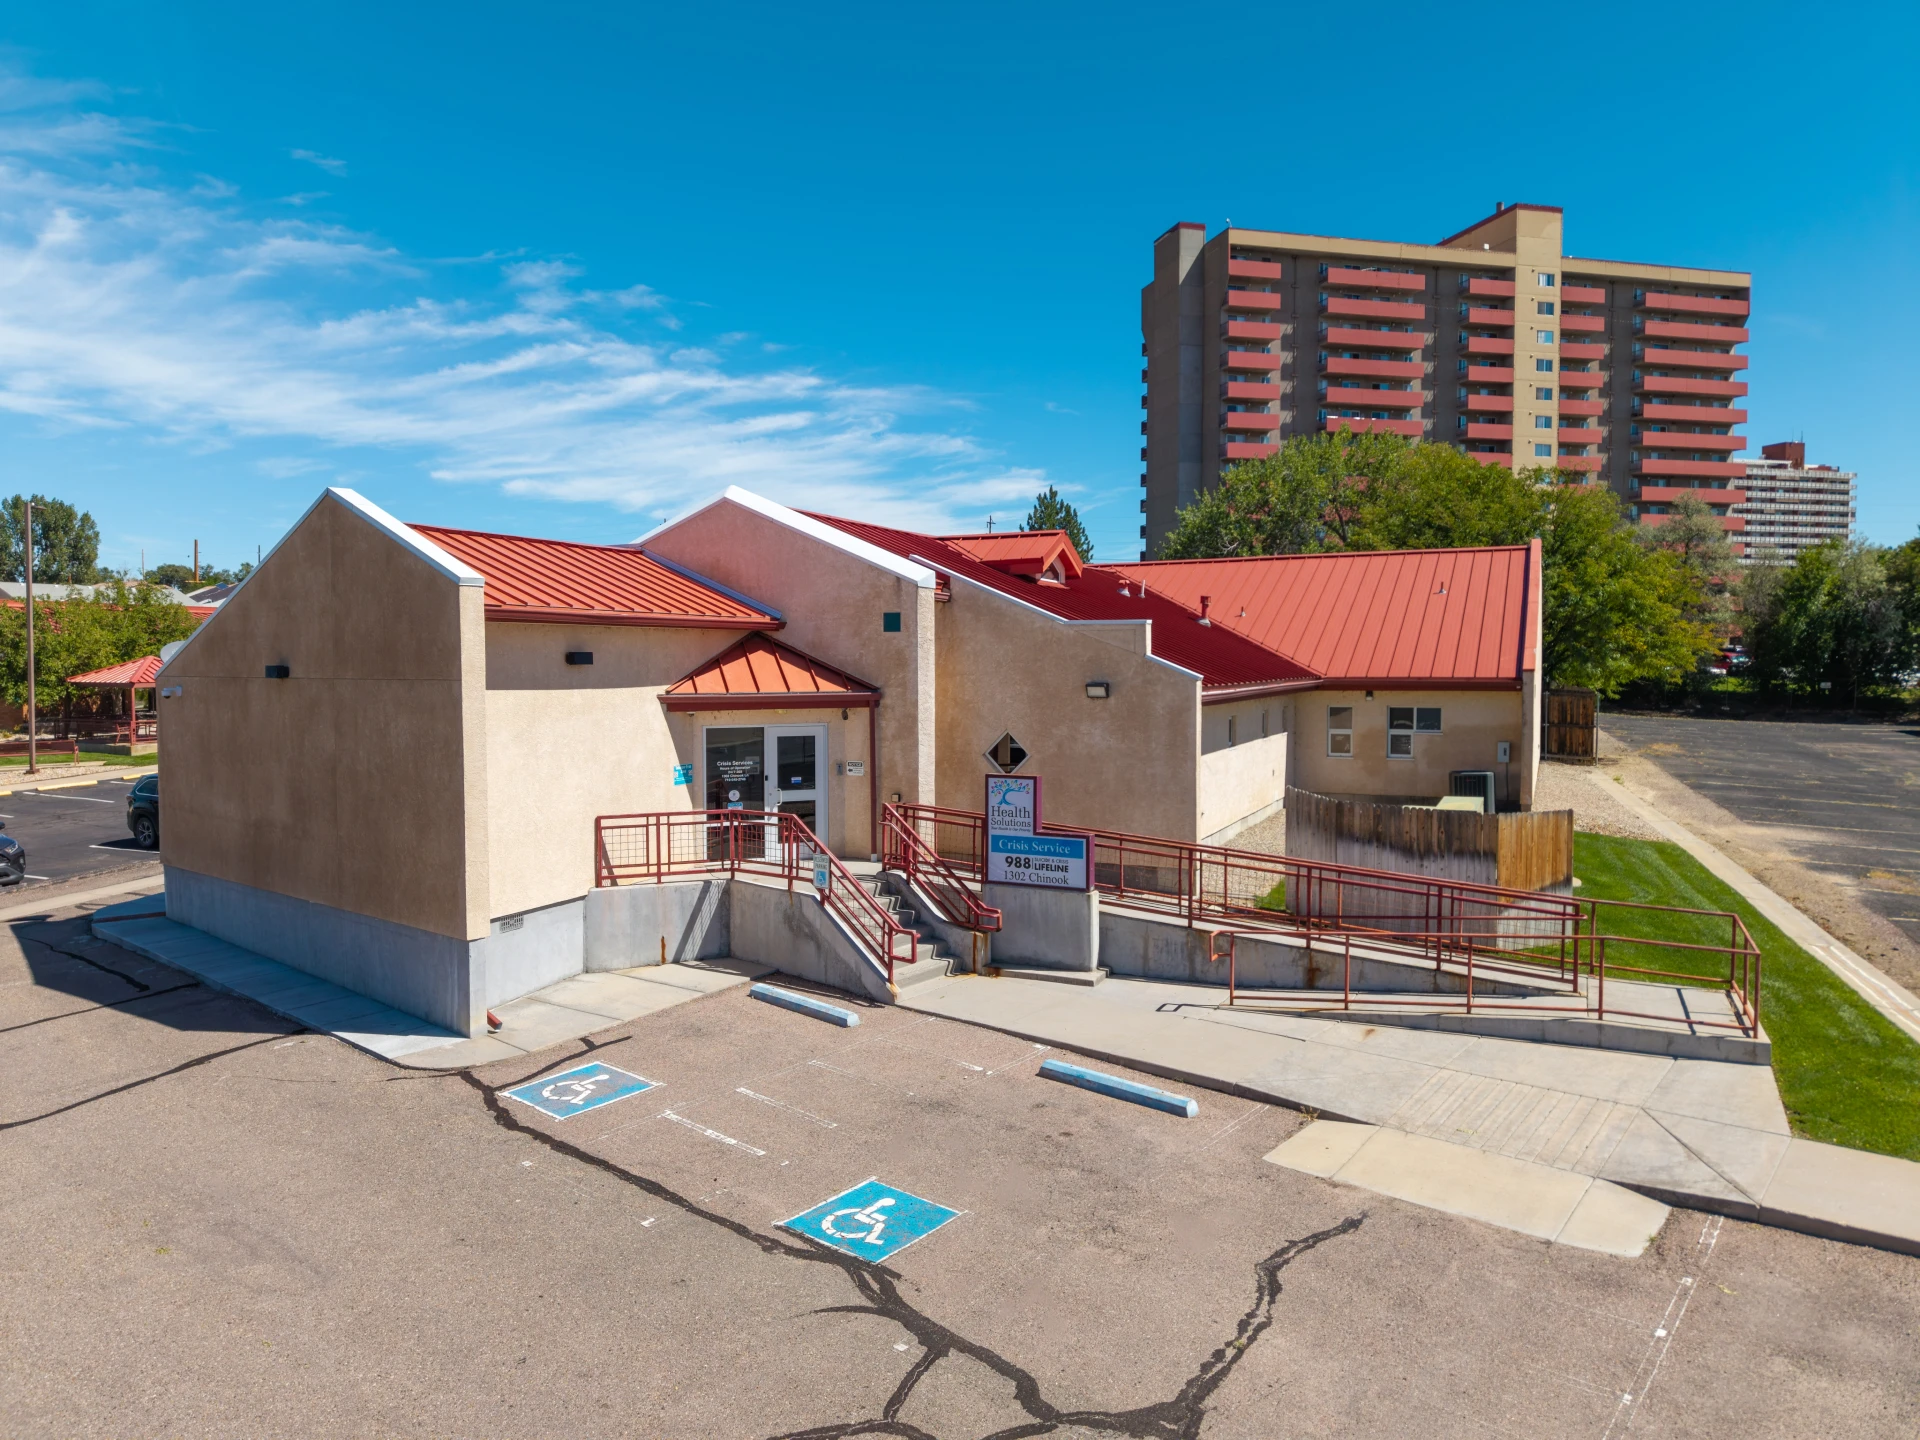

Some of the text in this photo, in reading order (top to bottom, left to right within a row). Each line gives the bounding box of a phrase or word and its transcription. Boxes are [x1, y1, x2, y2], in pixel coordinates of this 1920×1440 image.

[991, 805, 1031, 819] Health
[990, 817, 1031, 828] Solutions
[999, 838, 1071, 854] Crisis Service
[1005, 855, 1031, 869] 988
[1034, 862, 1069, 873] LIFELINE
[1004, 870, 1069, 885] 1302 Chinook
